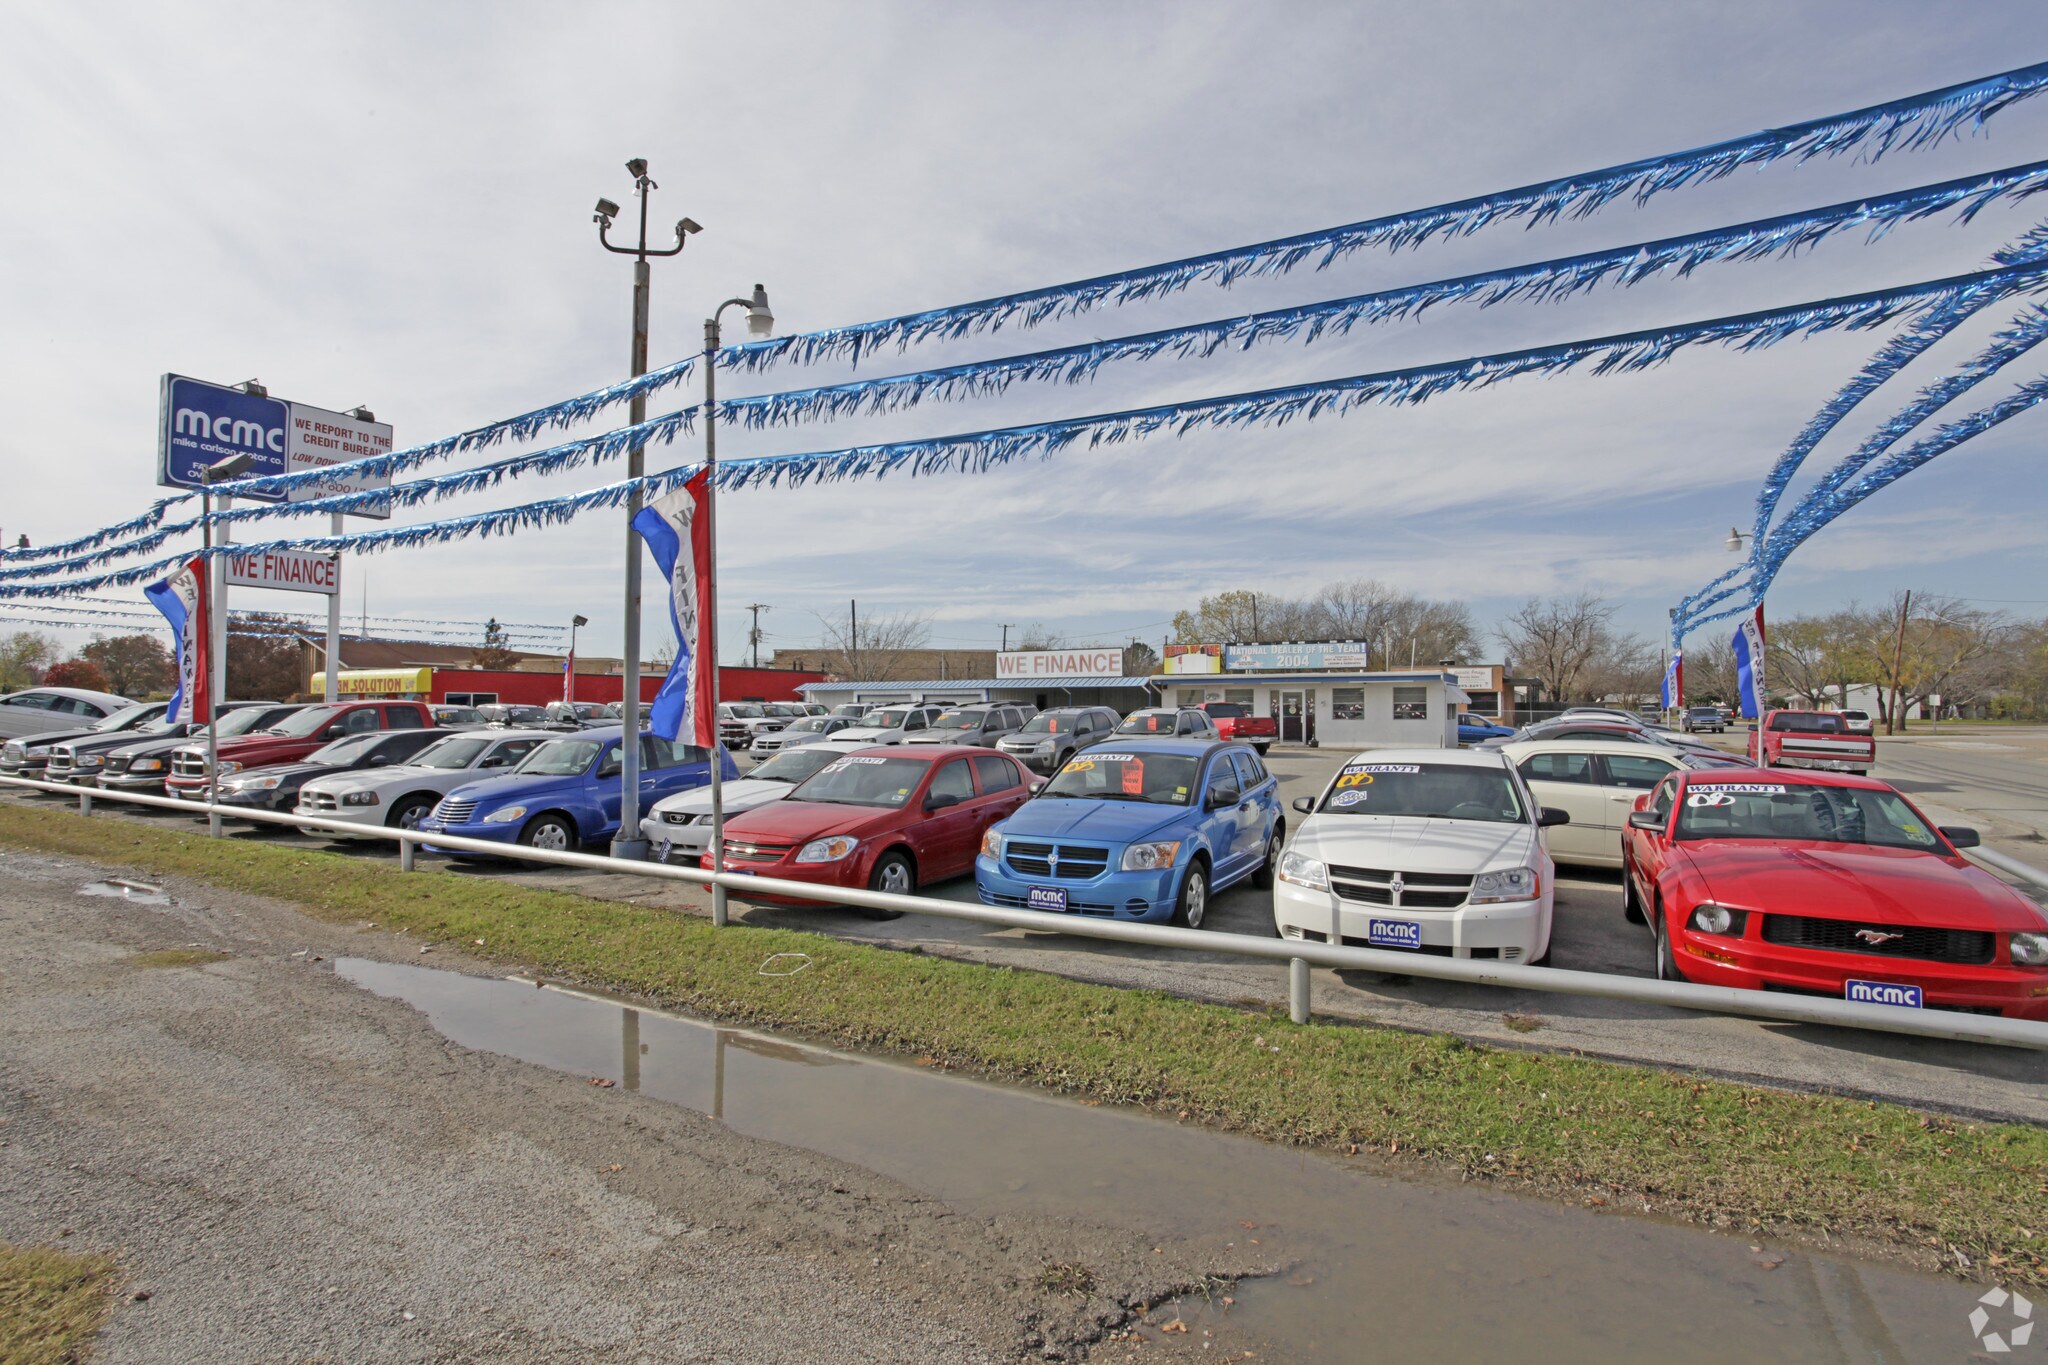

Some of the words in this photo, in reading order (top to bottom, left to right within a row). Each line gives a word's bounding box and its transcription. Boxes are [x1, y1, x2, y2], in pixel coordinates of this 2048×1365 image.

[175, 408, 284, 453] mcmc
[295, 418, 311, 430] WE
[315, 422, 353, 439] REPORT
[357, 431, 369, 443] TO
[373, 435, 390, 448] THE
[172, 437, 198, 449] mike
[200, 442, 237, 456] carlson
[270, 457, 284, 466] co.
[303, 433, 340, 450] CREDIT
[343, 441, 381, 456] BUREAU
[292, 452, 314, 463] LOW
[315, 456, 343, 466] DOW
[231, 552, 258, 579] WE
[264, 554, 335, 587] FINANCE
[1306, 645, 1316, 654] OF
[1319, 645, 1334, 654] THE
[998, 656, 1027, 674] WE
[1034, 653, 1121, 673] FINANCE
[1276, 655, 1310, 667] 2004
[350, 678, 402, 692] SOLUTION
[1346, 765, 1418, 773] WARRANTY
[1031, 889, 1064, 903] mcmc
[1372, 923, 1417, 939] mcmc
[1851, 984, 1916, 1006] mcmc
